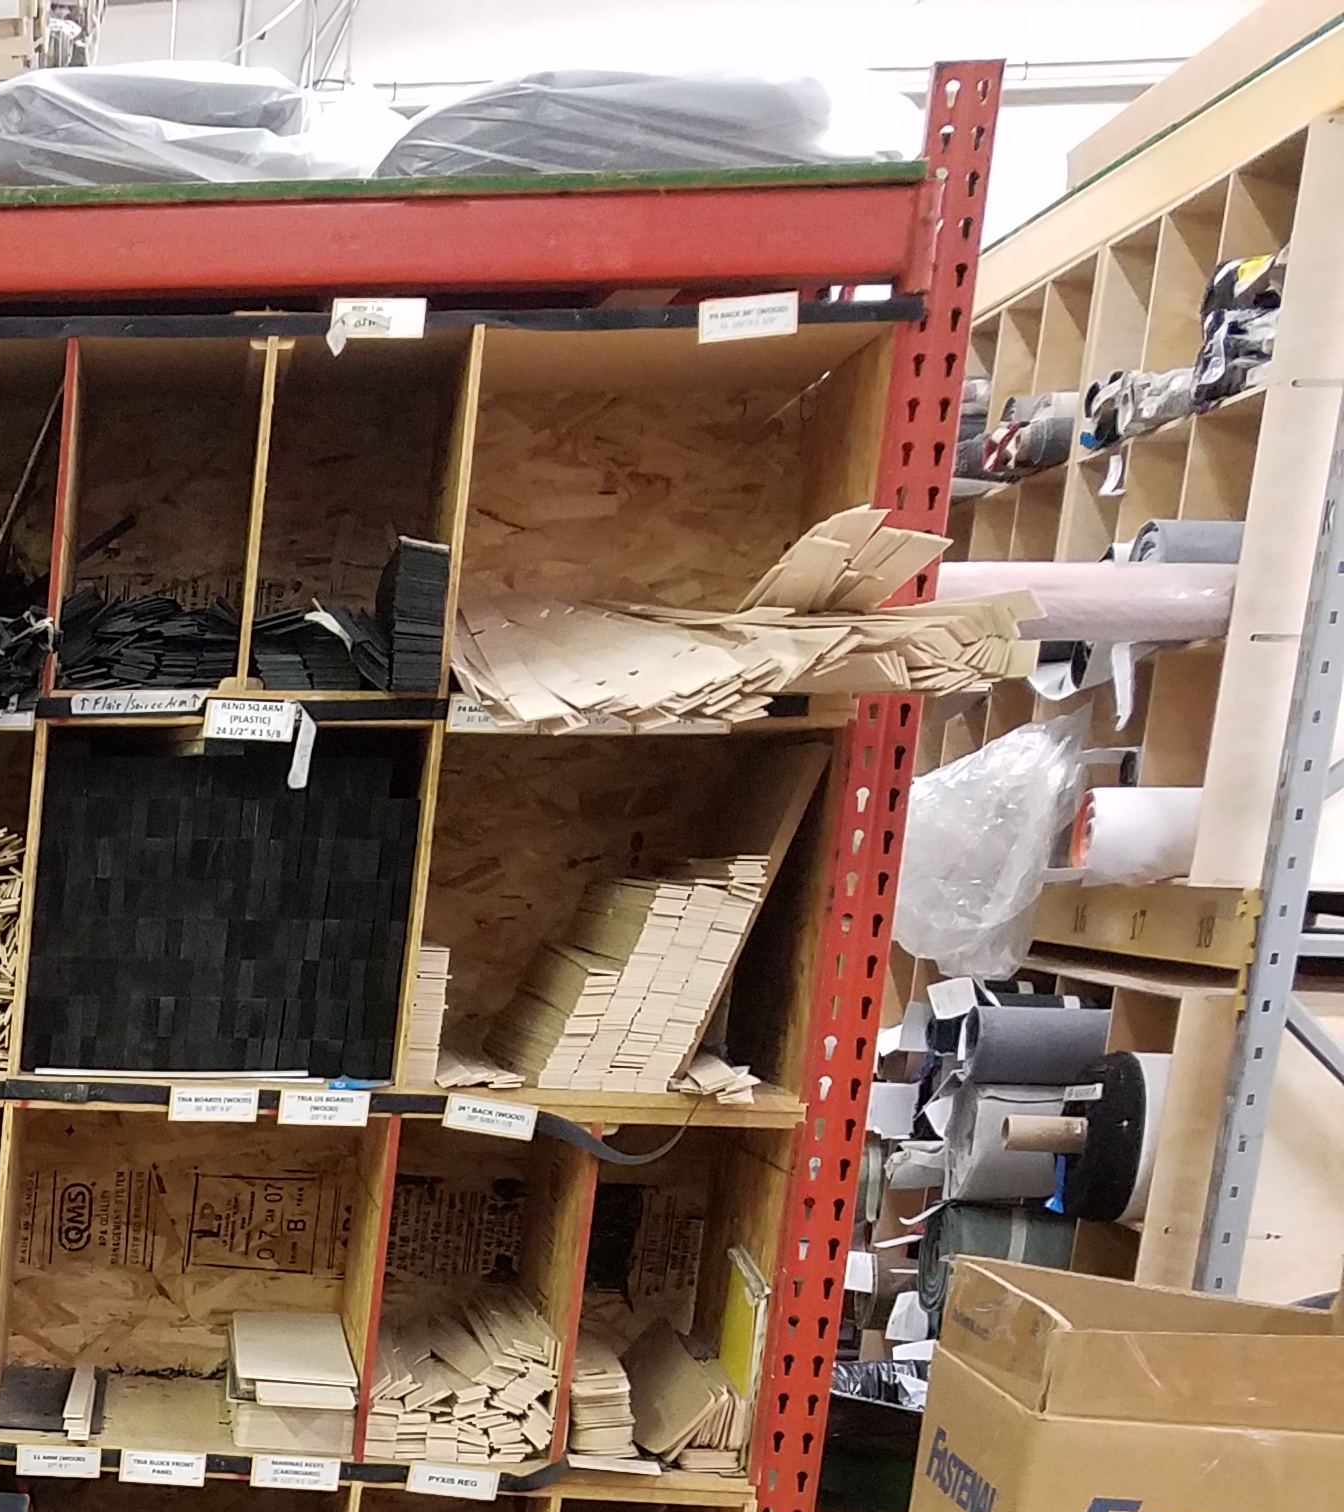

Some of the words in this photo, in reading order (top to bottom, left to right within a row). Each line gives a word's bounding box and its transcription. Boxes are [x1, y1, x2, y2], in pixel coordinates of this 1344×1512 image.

[262, 704, 284, 713] ARM
[230, 714, 272, 726] (PLASTIC)
[216, 726, 226, 735] 24
[1129, 910, 1146, 940] 17
[472, 1107, 494, 1116] BACK
[64, 1190, 87, 1244] QMS
[428, 1475, 455, 1484] PYXIS
[457, 1478, 478, 1487] REG
